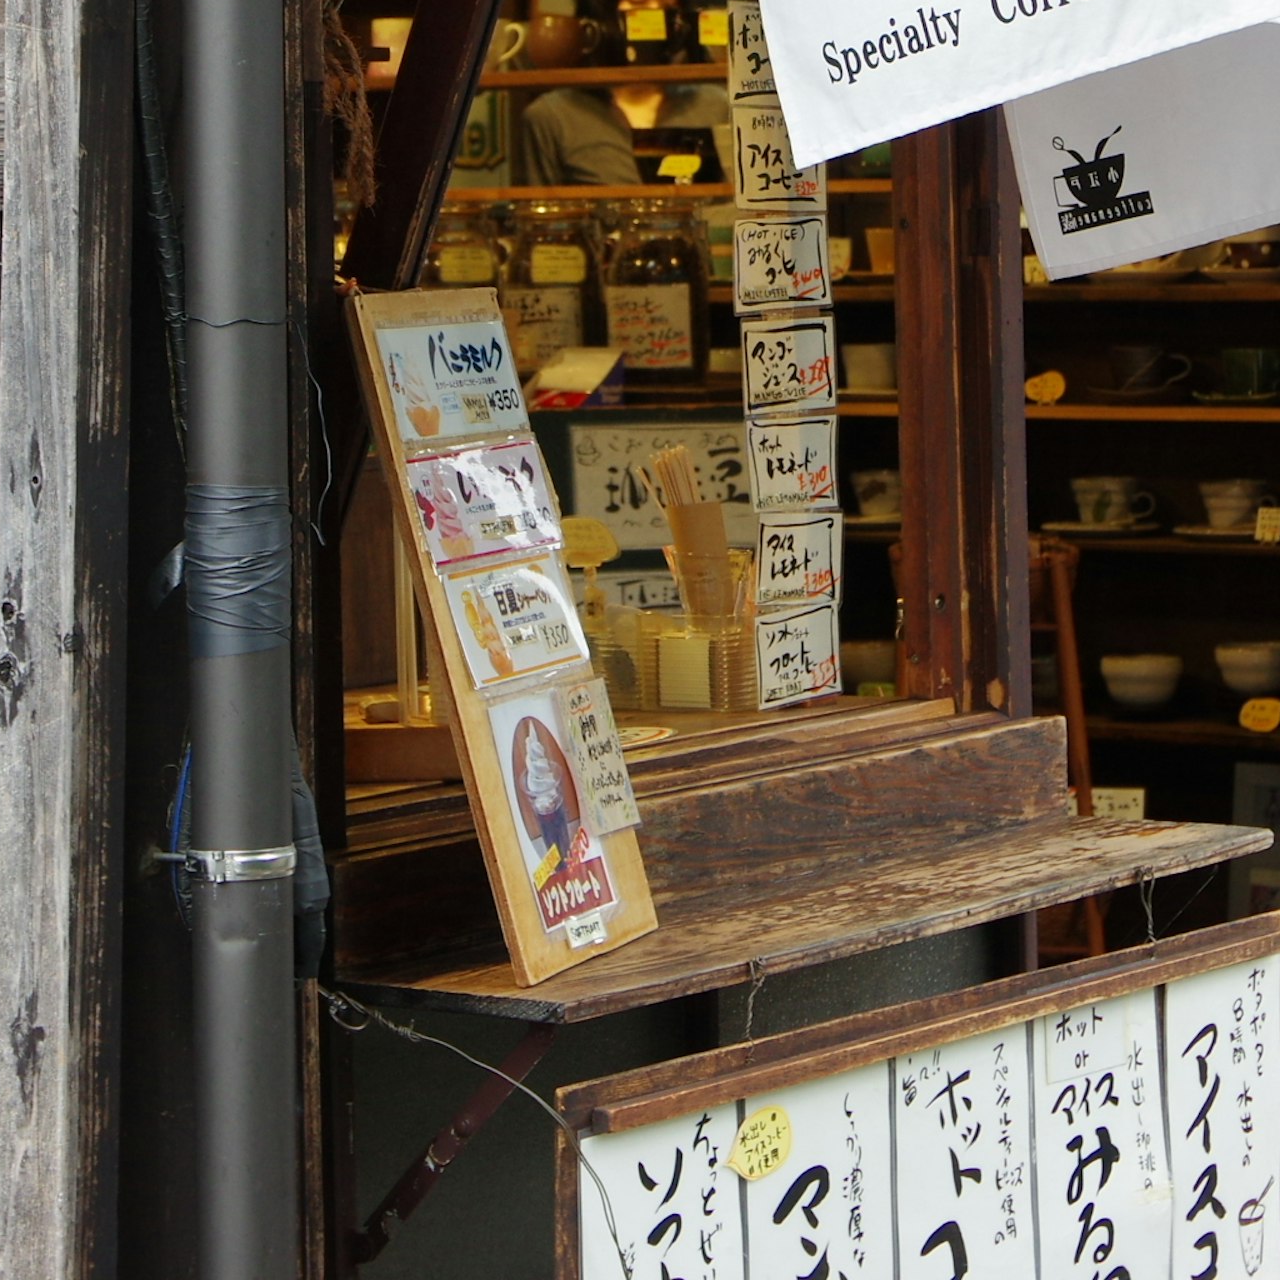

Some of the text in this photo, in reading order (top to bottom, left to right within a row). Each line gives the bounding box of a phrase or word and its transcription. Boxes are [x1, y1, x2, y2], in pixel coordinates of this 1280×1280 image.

[822, 6, 962, 85] Specialty
[747, 143, 784, 169] アイス
[486, 388, 520, 412] ¥350
[542, 624, 569, 649] ¥350
[1056, 1007, 1104, 1043] ホット
[1075, 1050, 1089, 1069] or
[1051, 1072, 1120, 1125] アイス
